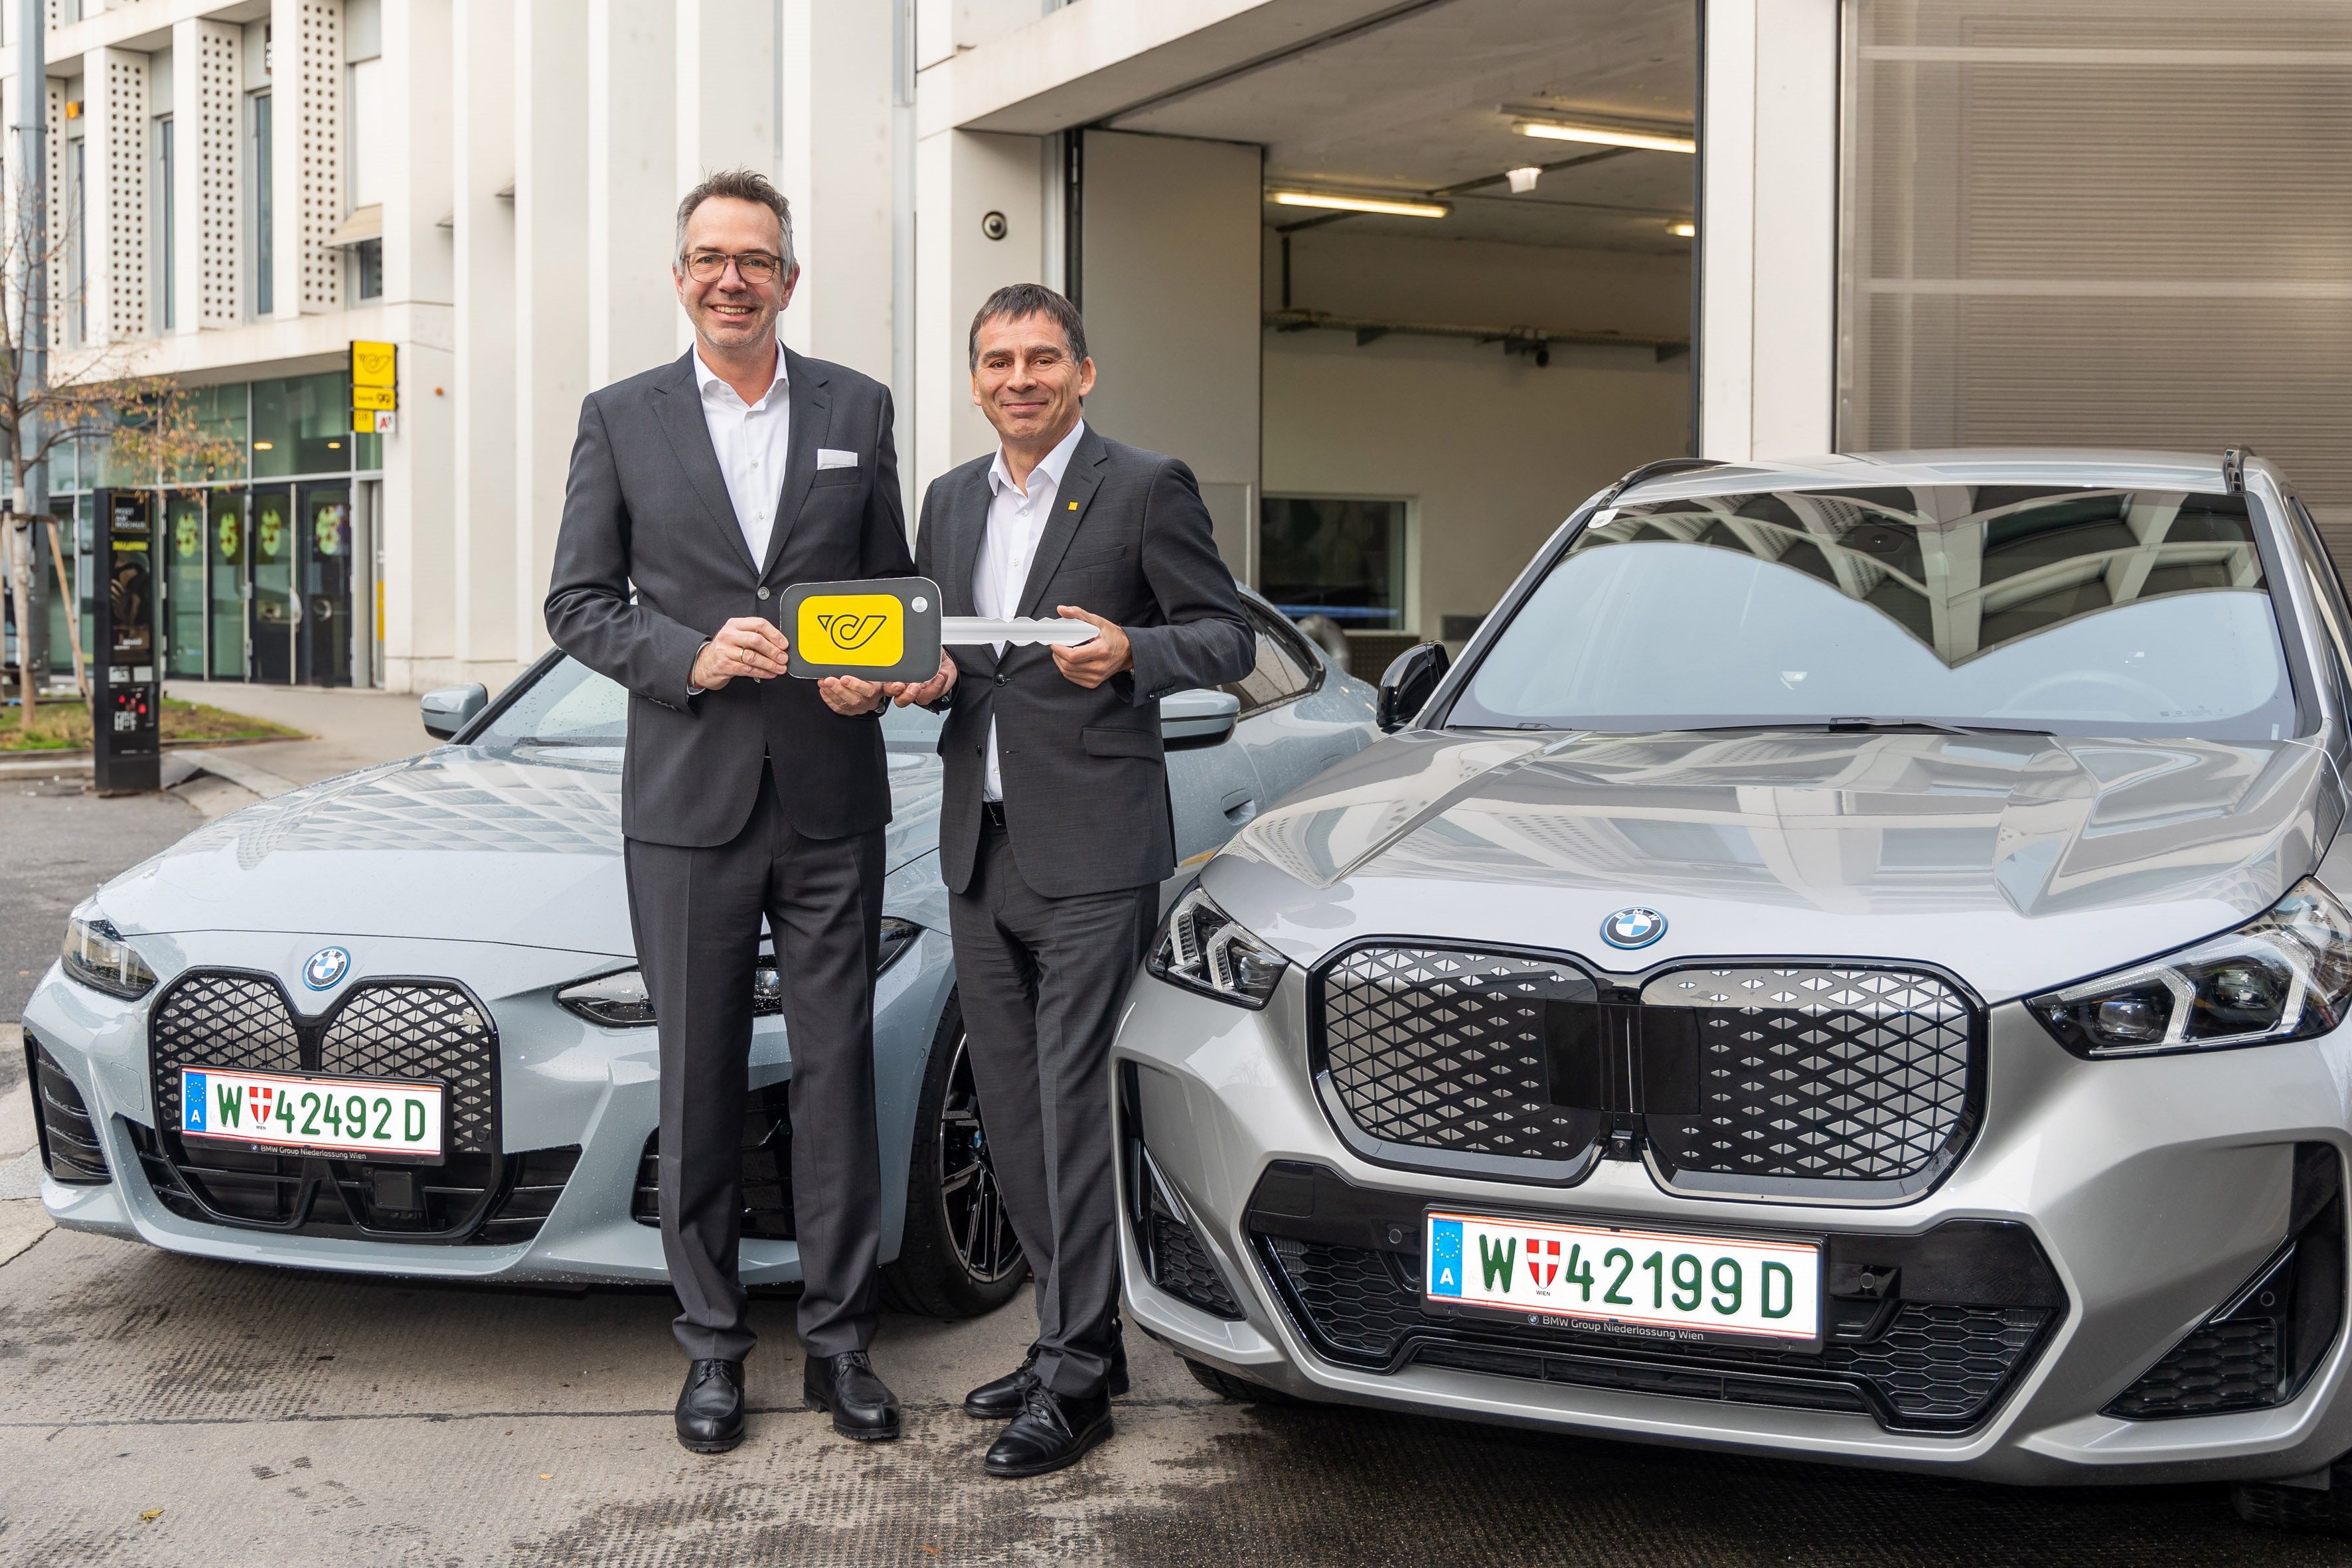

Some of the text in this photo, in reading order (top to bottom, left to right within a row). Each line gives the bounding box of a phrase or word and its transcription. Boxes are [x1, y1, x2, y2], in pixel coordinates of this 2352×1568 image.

[1614, 908, 1660, 921] BMW
[191, 1109, 201, 1123] A
[217, 1083, 426, 1142] W 42492 D
[261, 1144, 278, 1153] BMW
[279, 1146, 299, 1156] Group
[300, 1148, 348, 1160] Niederlassung
[1439, 1267, 1454, 1286] A
[1479, 1234, 1793, 1319] W 42199 D
[1543, 1316, 1704, 1340] BMW Group Niederlassung Wien
